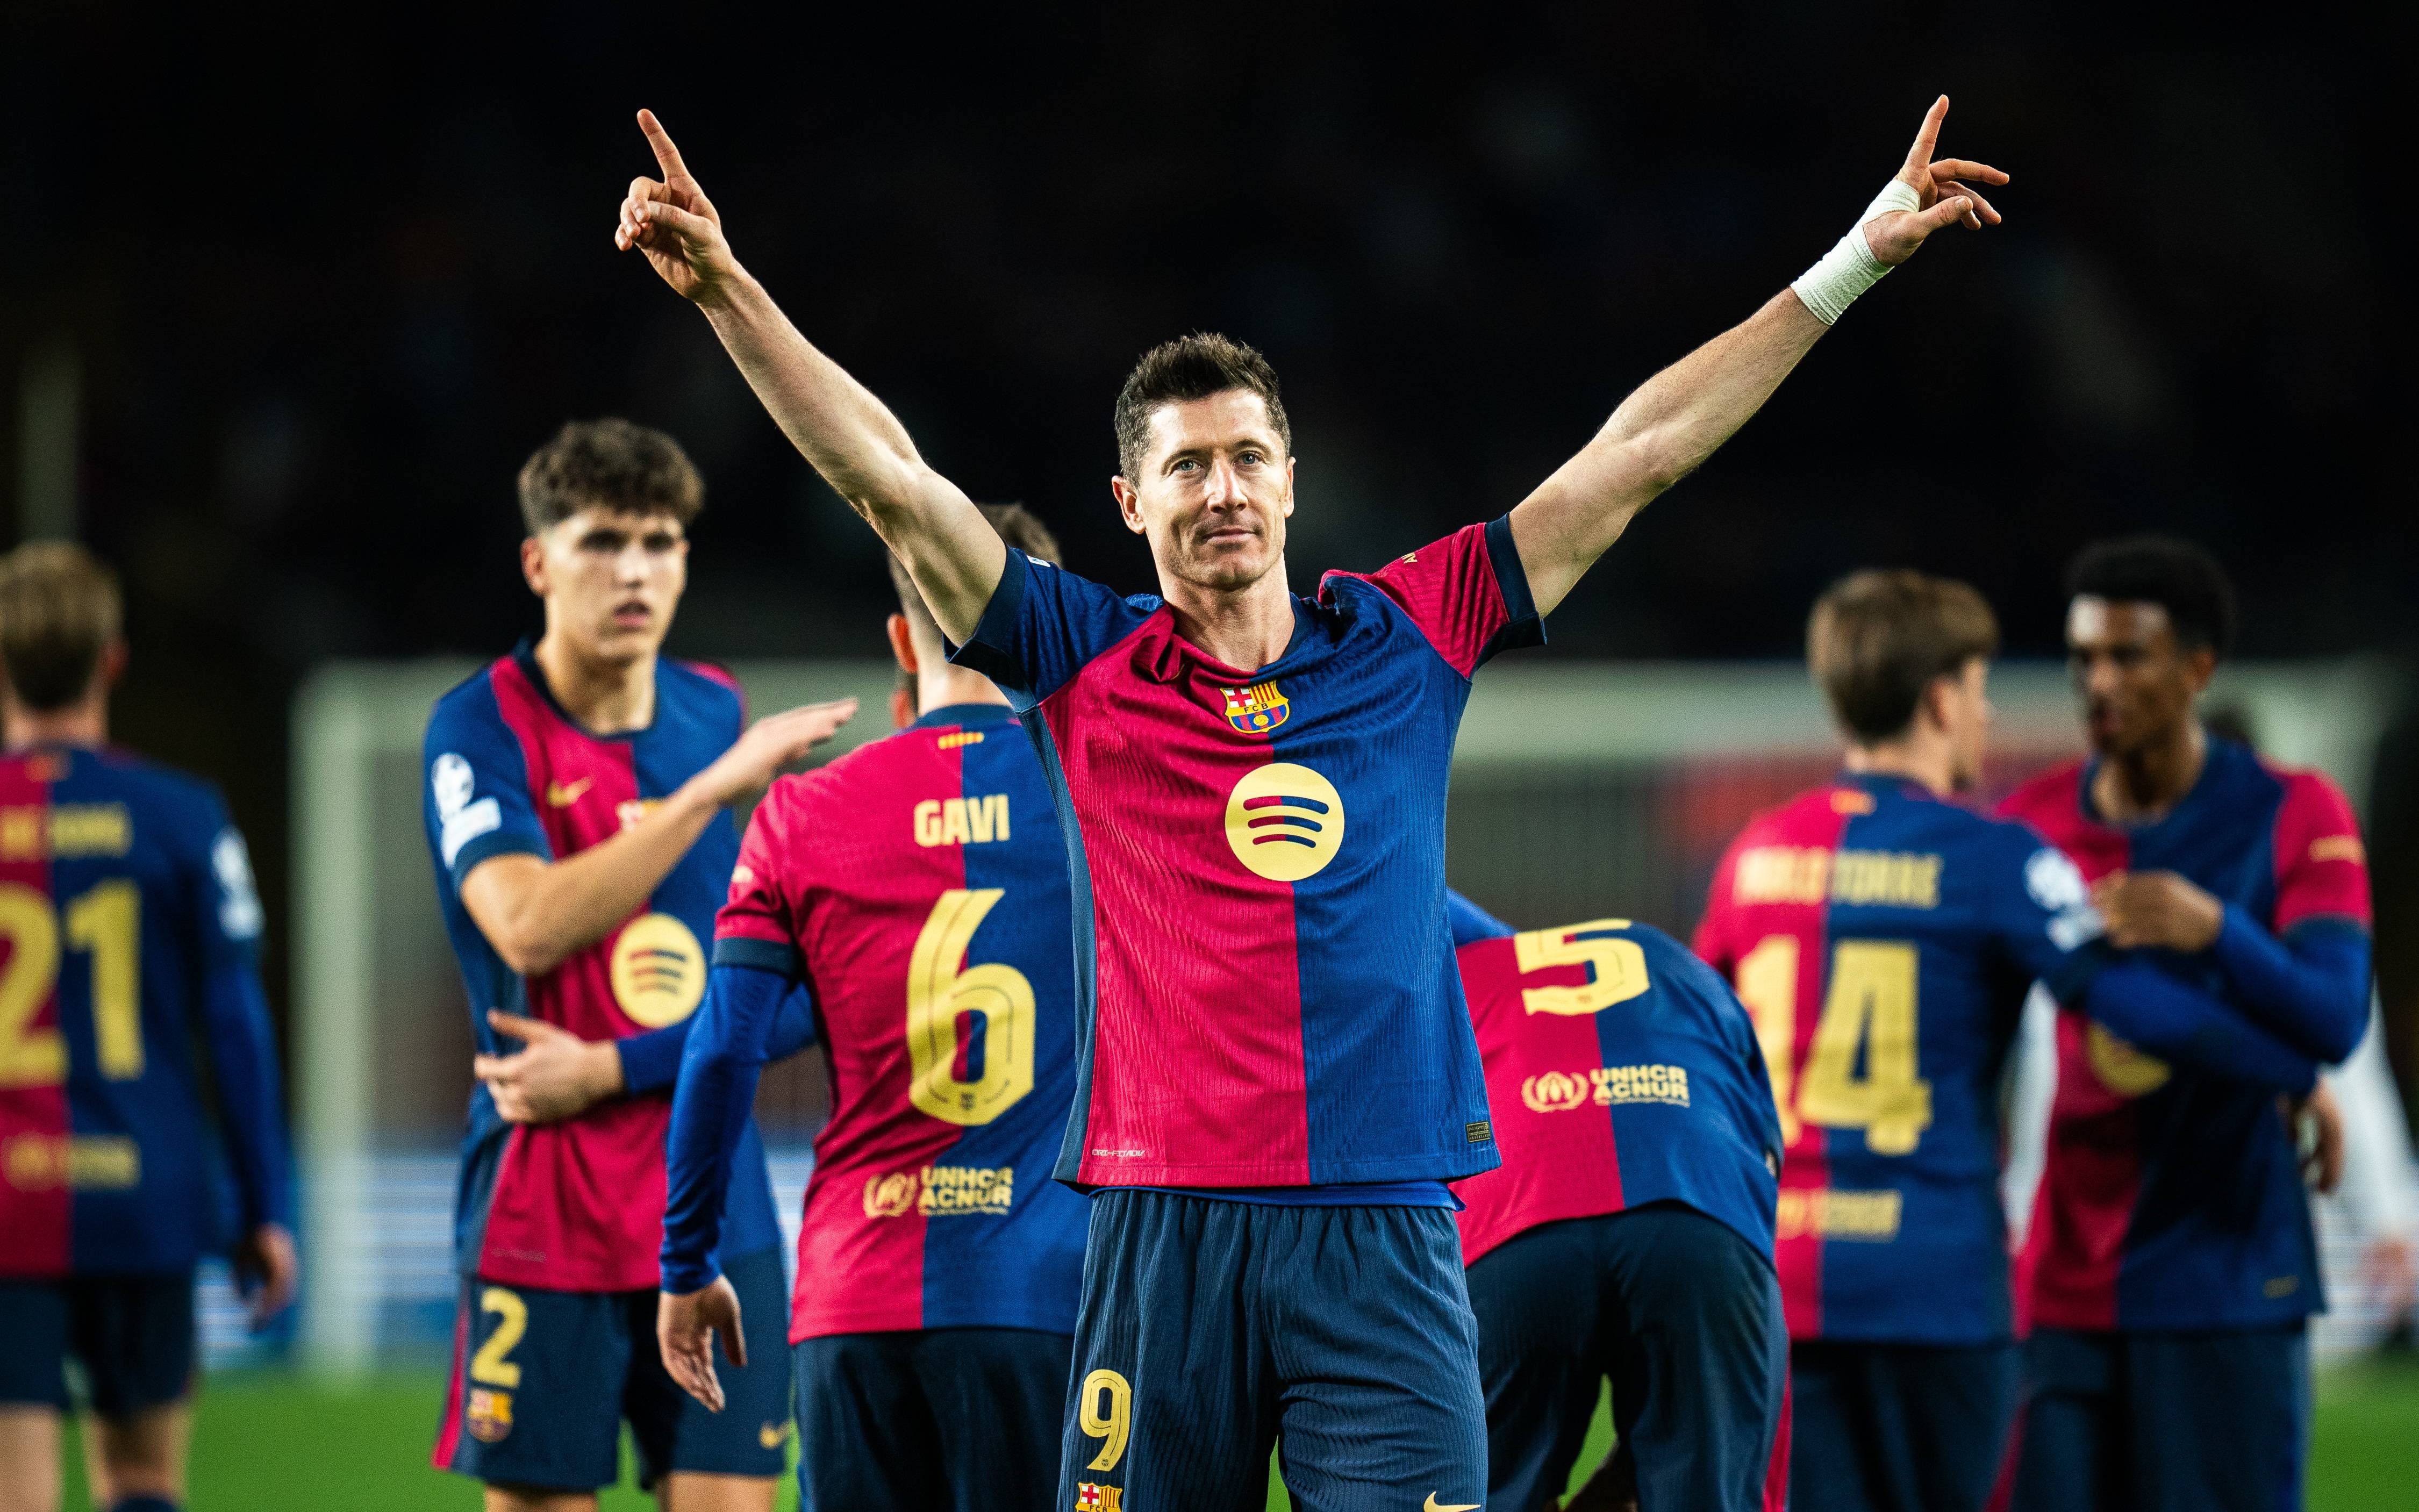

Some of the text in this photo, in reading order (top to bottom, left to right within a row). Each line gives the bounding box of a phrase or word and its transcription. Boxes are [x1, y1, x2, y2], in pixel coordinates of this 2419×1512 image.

[914, 794, 1010, 848] GAVI
[0, 879, 146, 1089] 21
[906, 888, 1036, 1126] 6
[1514, 918, 1650, 1016] 5
[1589, 1064, 1687, 1085] UNHCR
[1592, 1080, 1690, 1100] ACNUR
[1734, 934, 1933, 1156] 14
[917, 1185, 1012, 1208] ACNUR
[470, 1287, 528, 1388] 2
[1079, 1368, 1132, 1472] 9
